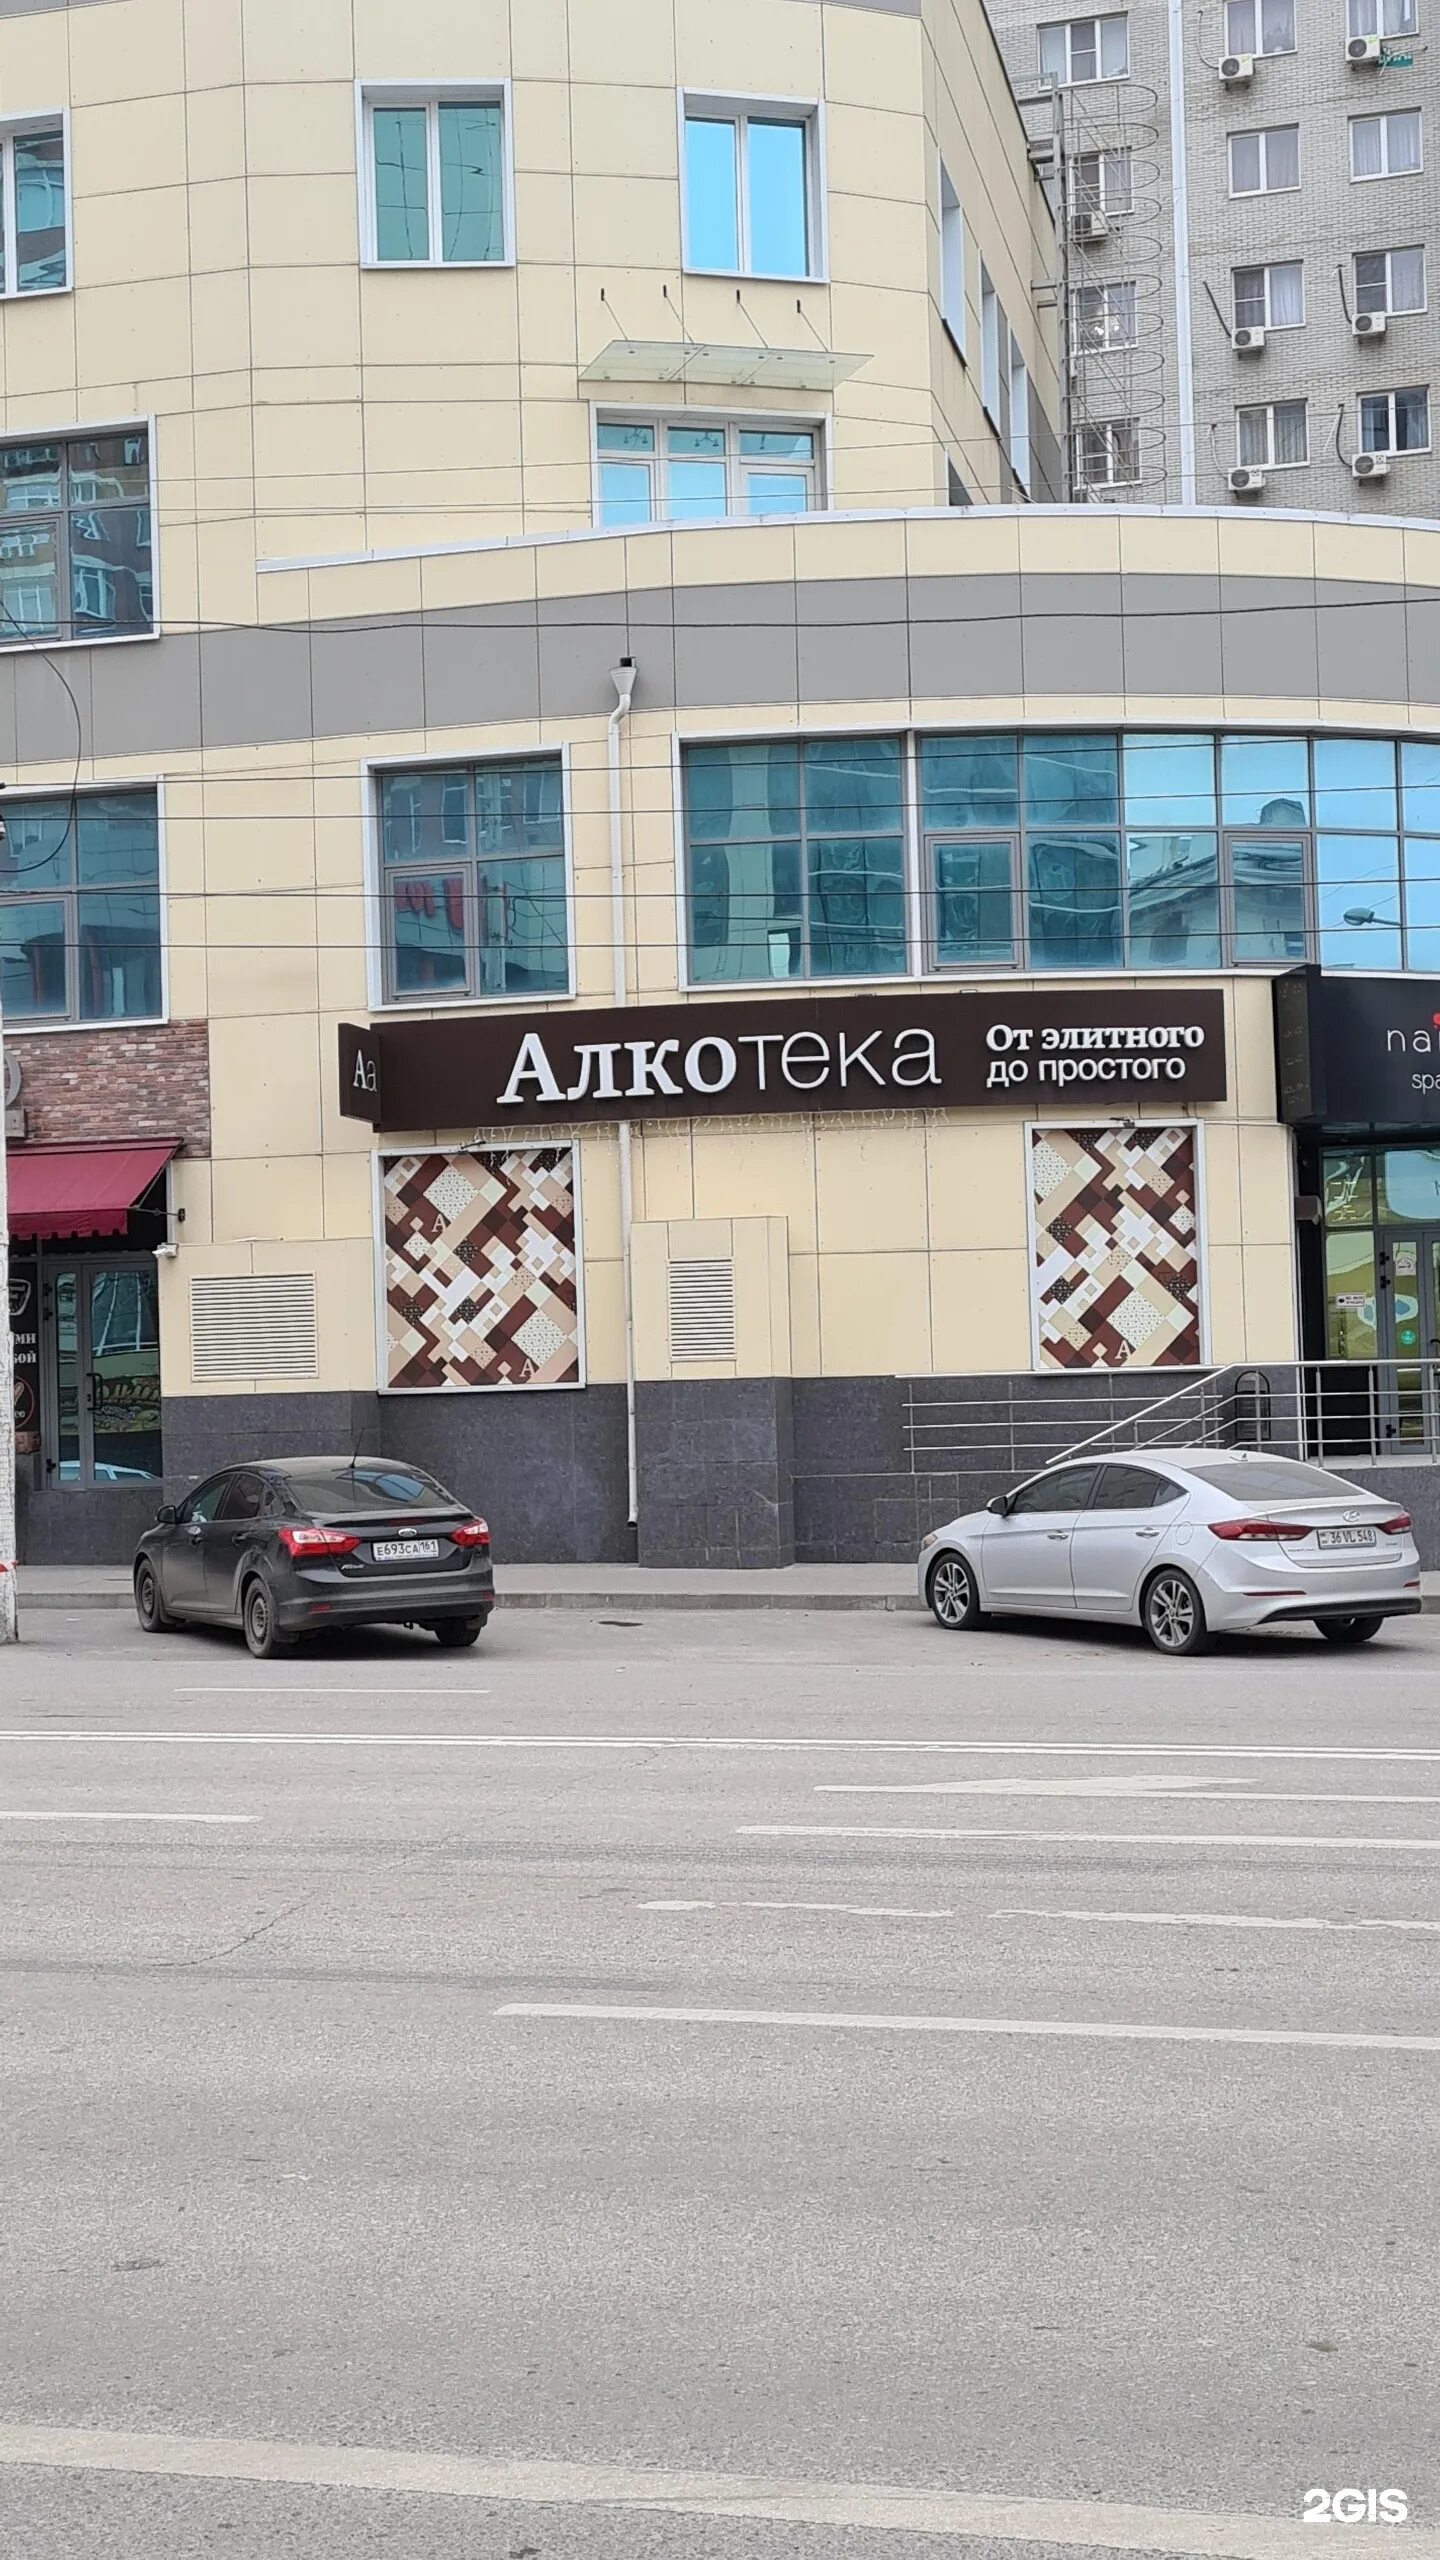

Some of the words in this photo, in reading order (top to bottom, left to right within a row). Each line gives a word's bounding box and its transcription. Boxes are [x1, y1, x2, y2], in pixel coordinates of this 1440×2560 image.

[986, 1024, 1033, 1051] От
[1041, 1026, 1205, 1050] элитного
[353, 1049, 378, 1093] Аа
[497, 1028, 942, 1104] Алкотека
[986, 1060, 1029, 1088] до
[1038, 1057, 1186, 1087] простого
